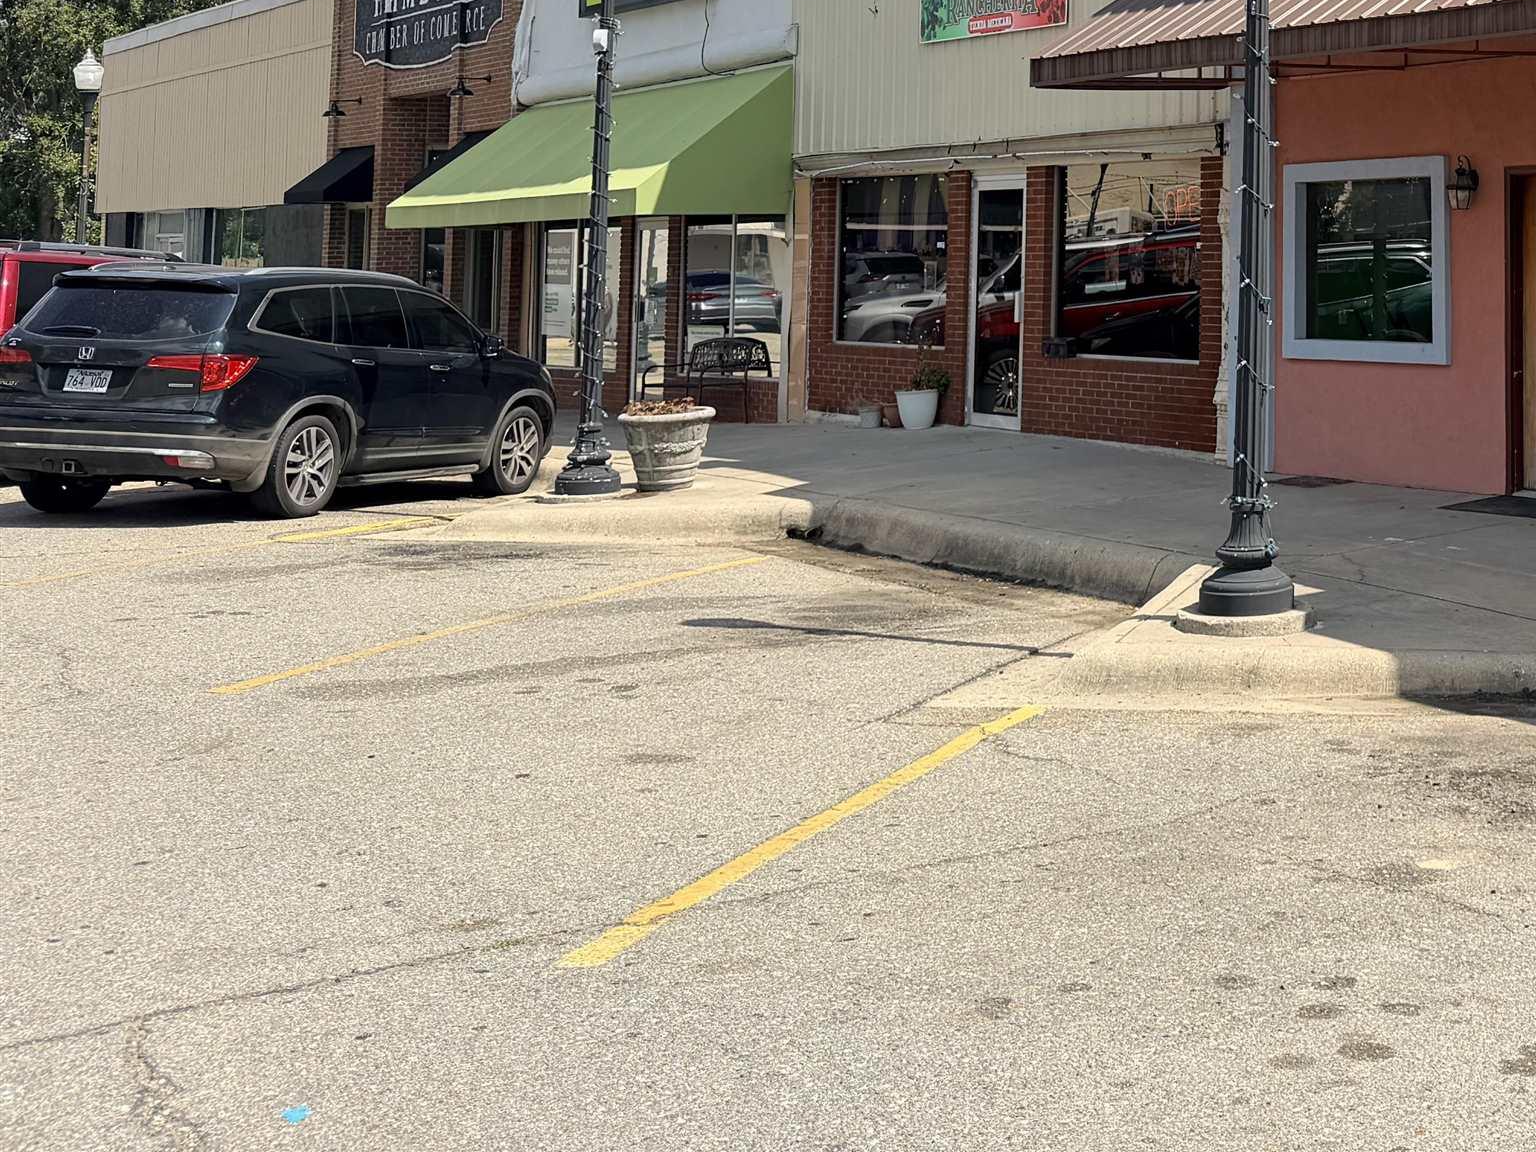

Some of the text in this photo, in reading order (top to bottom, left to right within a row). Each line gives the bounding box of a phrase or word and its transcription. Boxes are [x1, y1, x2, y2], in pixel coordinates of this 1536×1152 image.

[413, 19, 426, 45] OF
[430, 5, 486, 41] COMERCE
[1164, 185, 1201, 226] OPE
